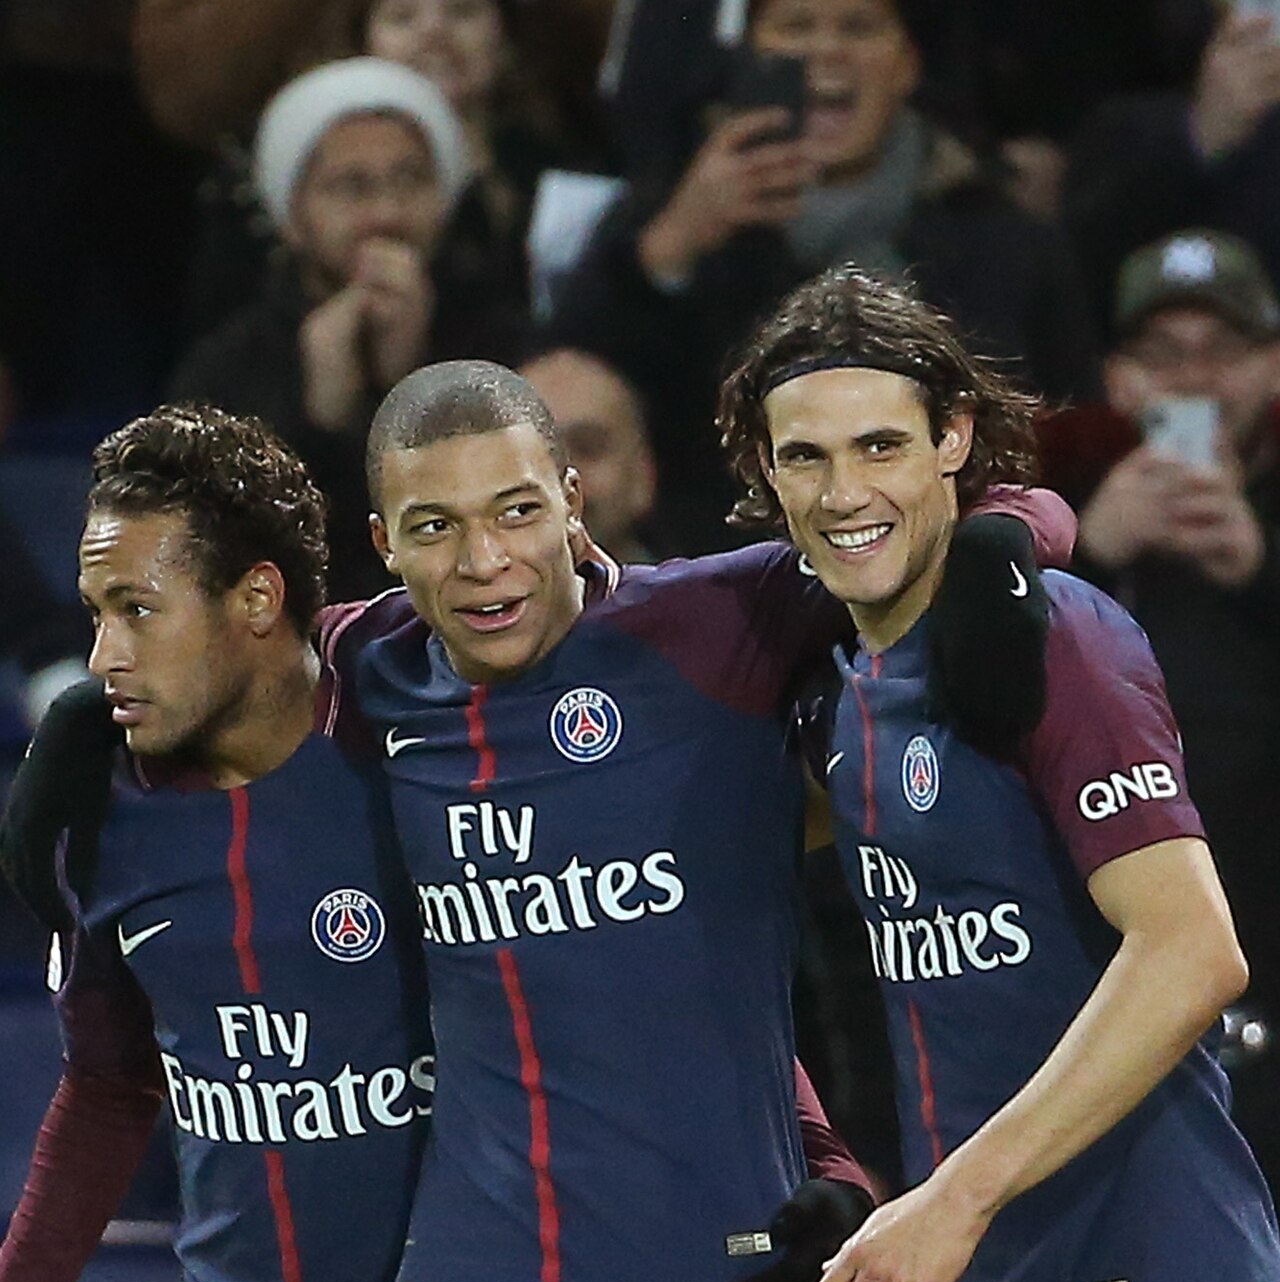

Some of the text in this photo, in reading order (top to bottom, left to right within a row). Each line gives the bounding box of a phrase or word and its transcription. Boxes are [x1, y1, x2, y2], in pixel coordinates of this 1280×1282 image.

[1079, 763, 1179, 820] QNB
[447, 802, 534, 864] Fly
[417, 850, 685, 944] mirates
[858, 846, 918, 909] Fly
[215, 1004, 308, 1068] Fly
[160, 1054, 437, 1143] Emirates
